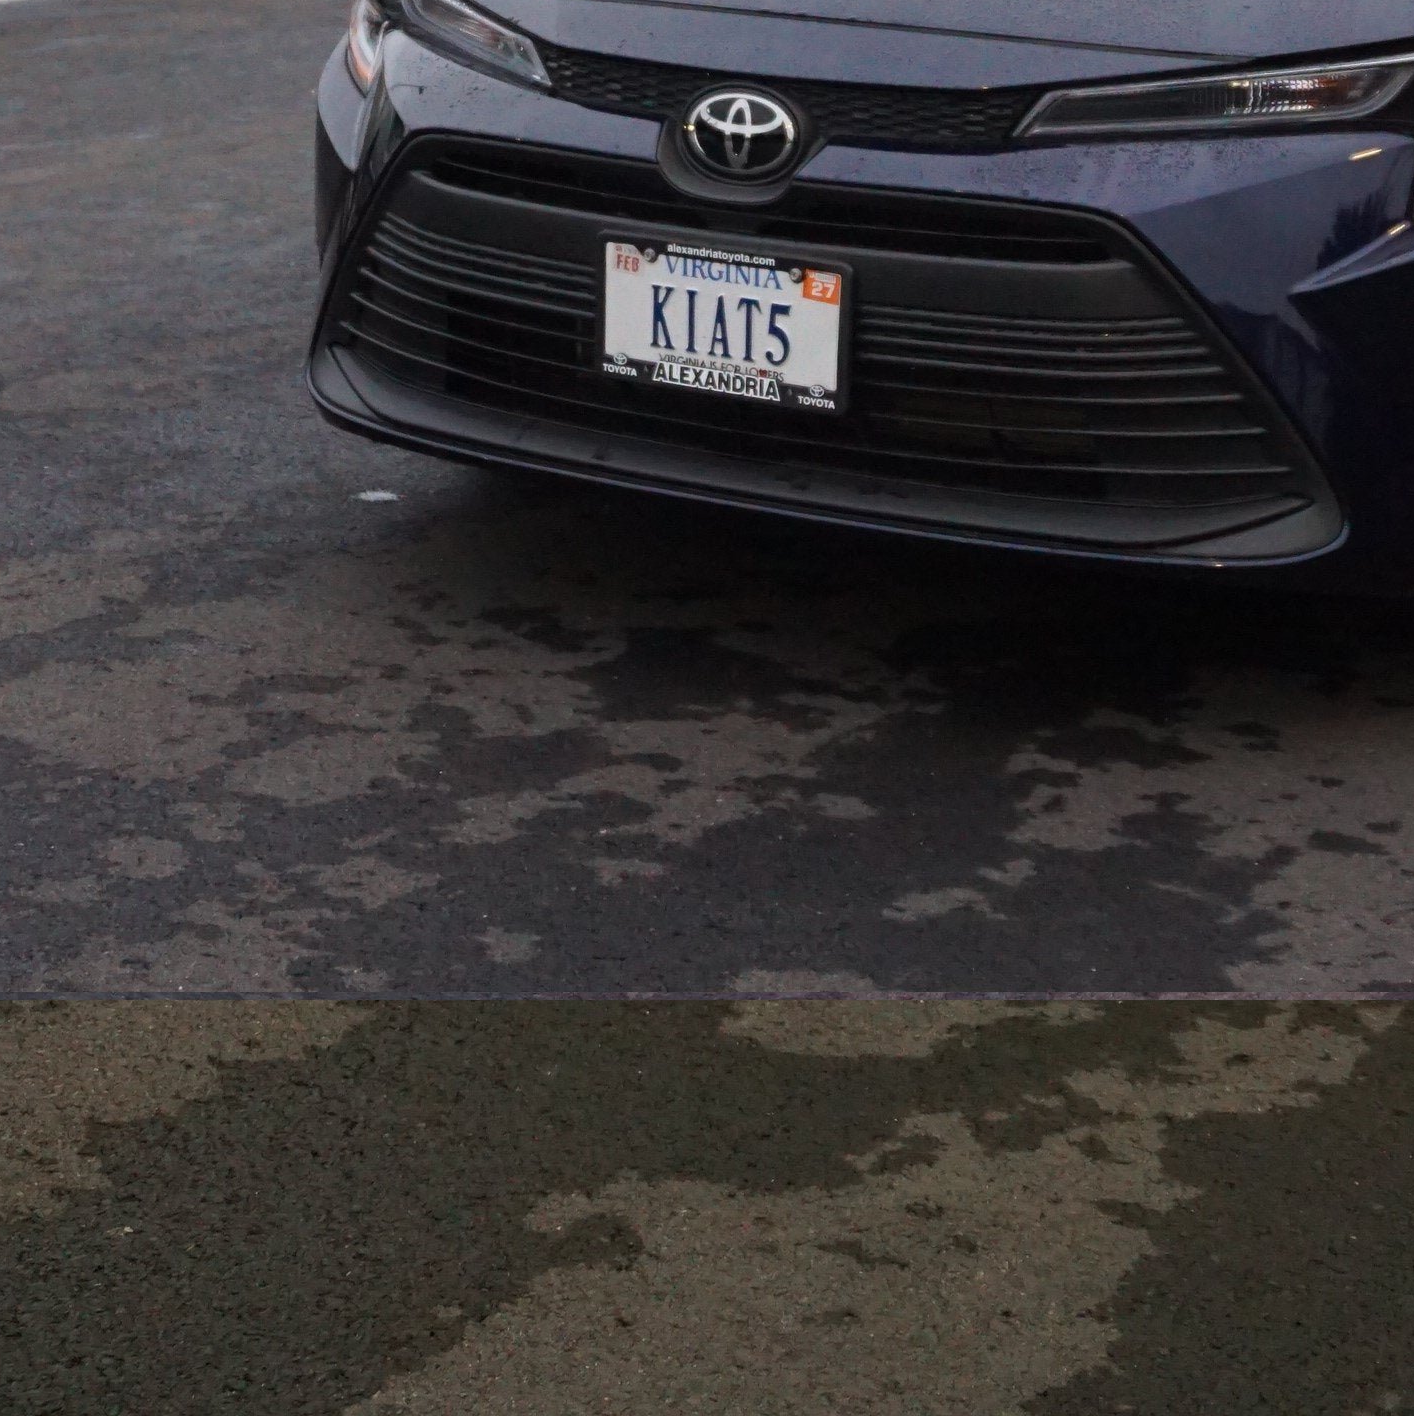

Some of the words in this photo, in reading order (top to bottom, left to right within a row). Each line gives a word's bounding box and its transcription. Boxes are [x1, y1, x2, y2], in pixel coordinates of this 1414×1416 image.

[615, 253, 640, 272] FEB
[667, 243, 776, 267] alexandriatoyota.com
[665, 251, 783, 290] VIRGINIA
[811, 280, 836, 298] 27
[650, 284, 792, 366] KIAT5
[602, 363, 637, 377] TOYOTA
[659, 353, 707, 368] VIRGINIA
[653, 361, 781, 402] ALEXANDRIA
[797, 395, 836, 410] TOYOTA
